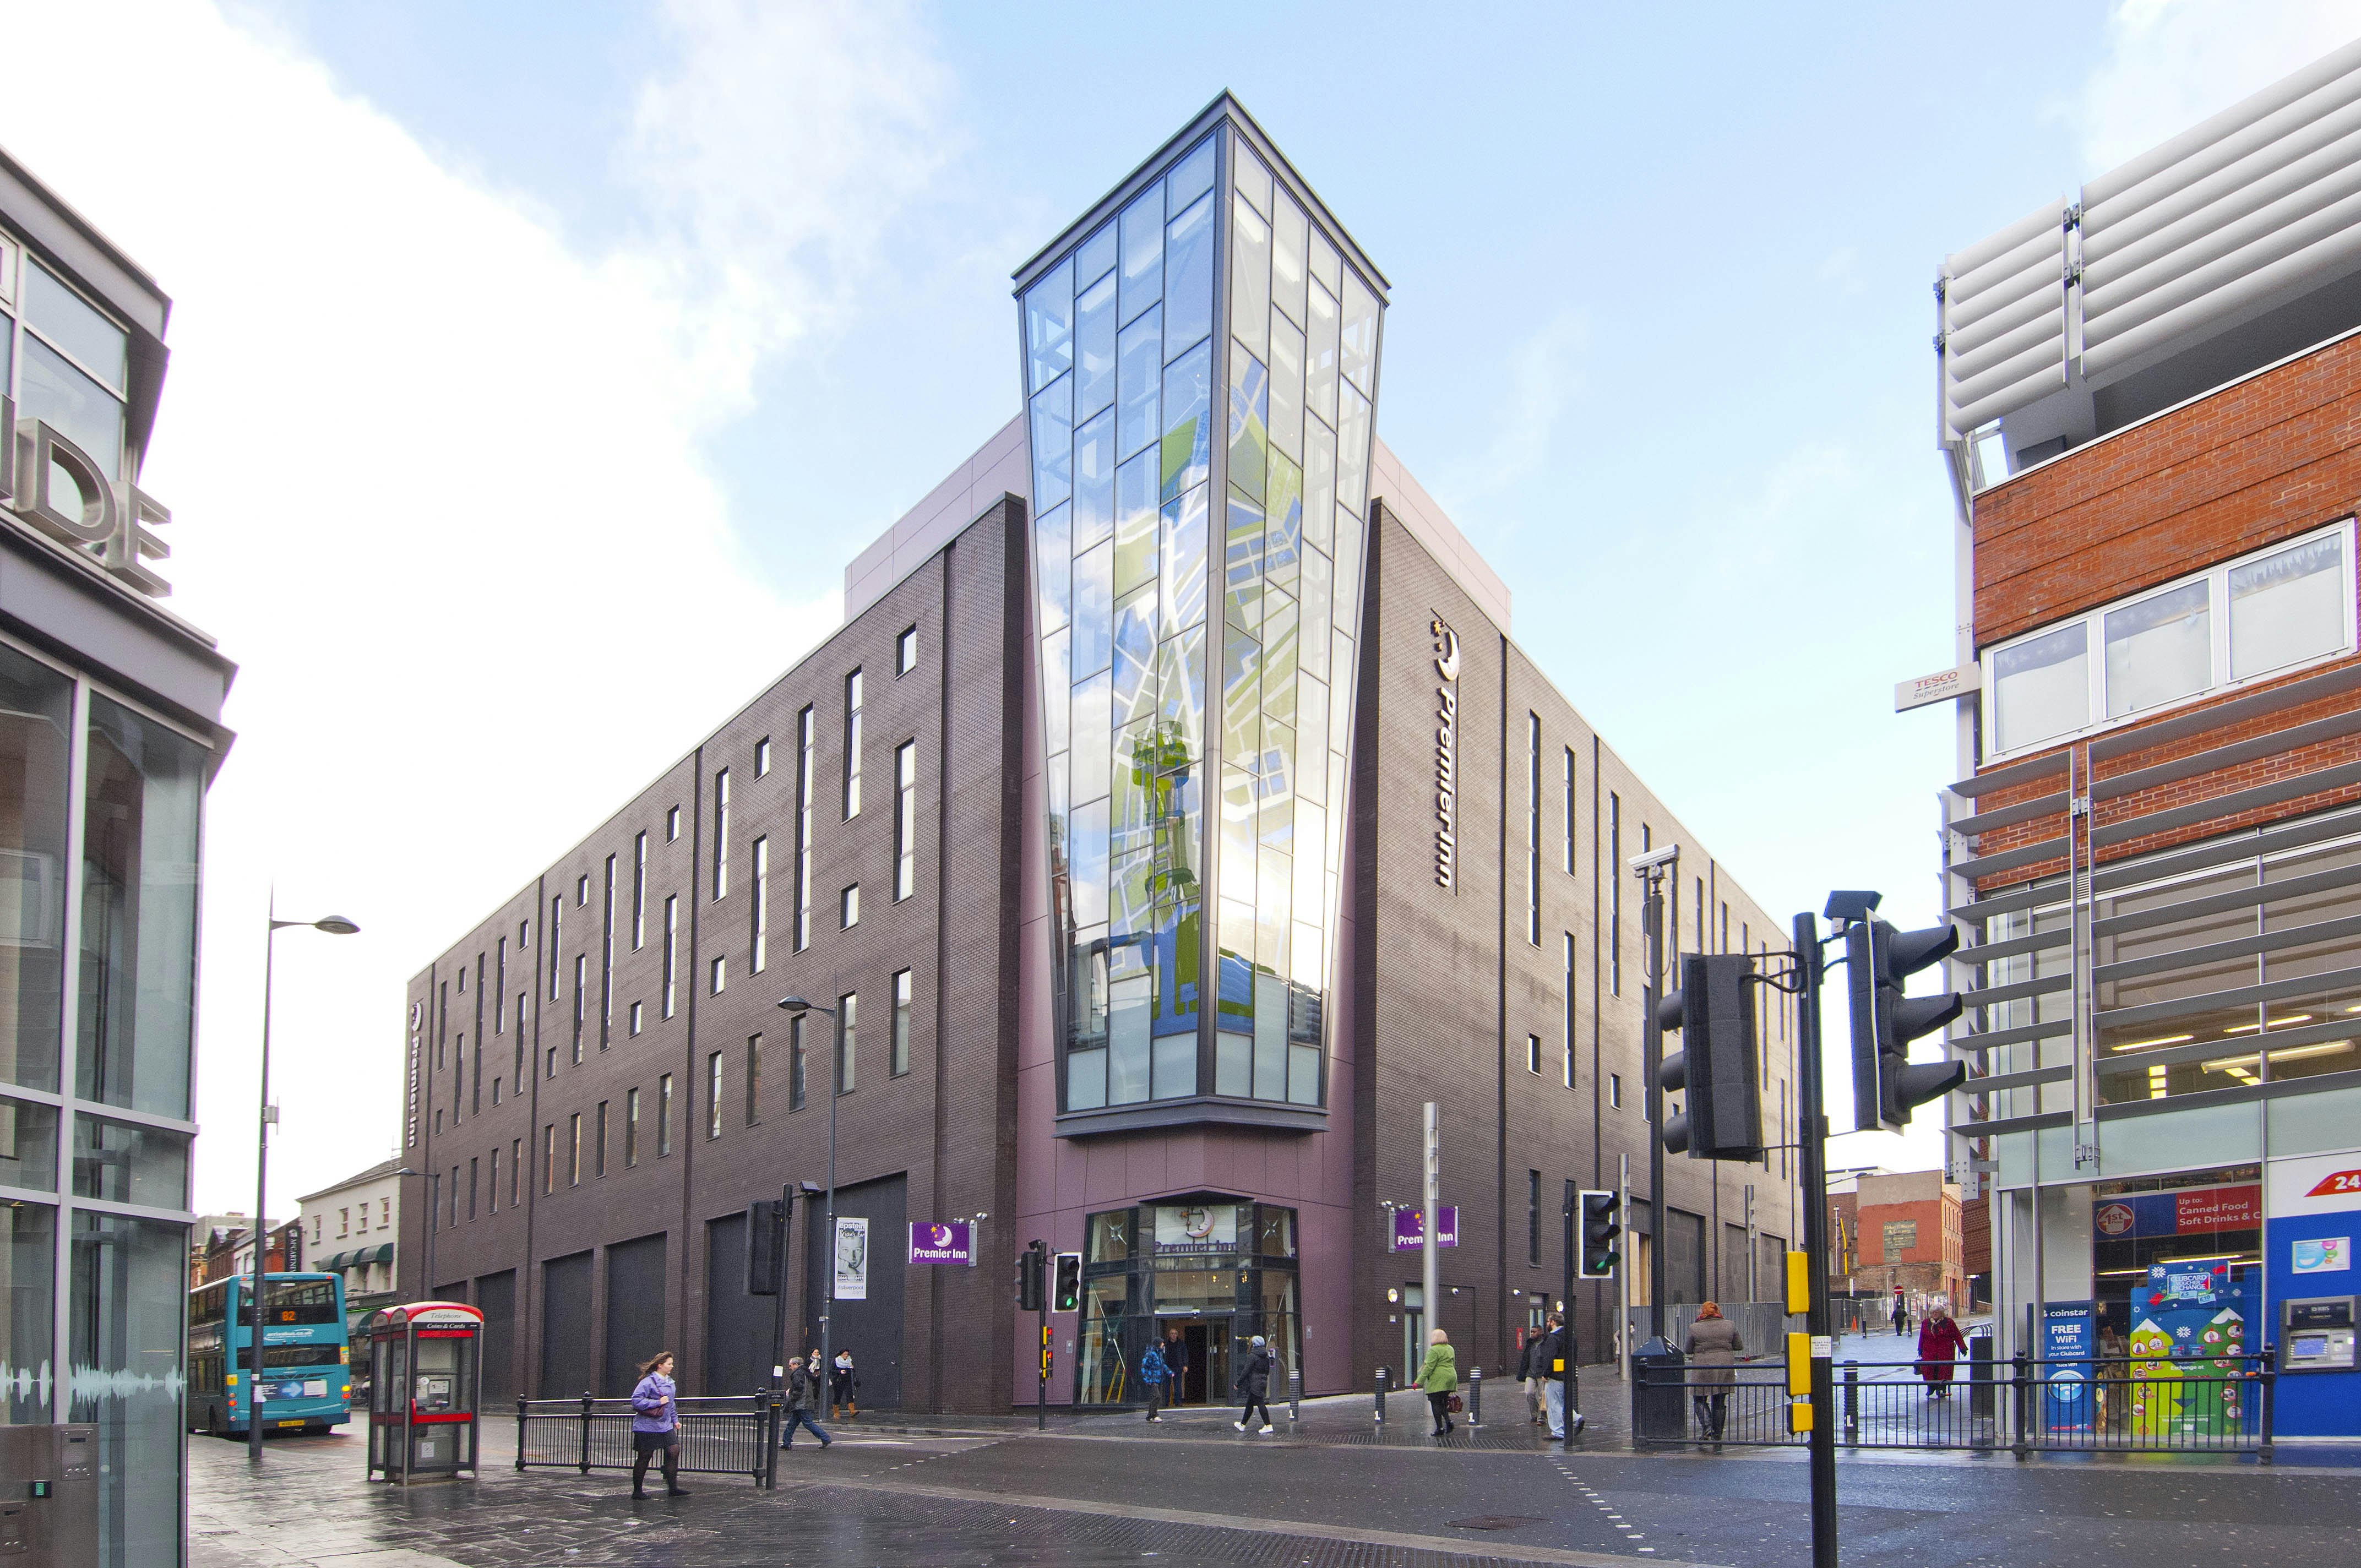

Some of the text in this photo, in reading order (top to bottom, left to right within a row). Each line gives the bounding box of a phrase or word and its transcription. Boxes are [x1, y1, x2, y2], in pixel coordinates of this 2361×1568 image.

[1915, 672, 1958, 688] TESCO
[1913, 683, 1960, 699] Superstore
[1438, 686, 1455, 888] Premier Inn
[409, 1036, 420, 1148] Premier Inn
[2335, 1174, 2361, 1190] 24
[2179, 1202, 2249, 1215] Canned Food
[2106, 1212, 2124, 1224] 1st
[2179, 1216, 2201, 1226] Soft
[2204, 1215, 2239, 1224] Drinks
[1398, 1232, 1454, 1245] Prem Inn
[1153, 1239, 1238, 1253] Premier Inn
[914, 1248, 967, 1259] Premier Inn
[281, 1310, 296, 1321] 82
[2051, 1324, 2081, 1334] FREE
[2055, 1335, 2077, 1343] WiFi
